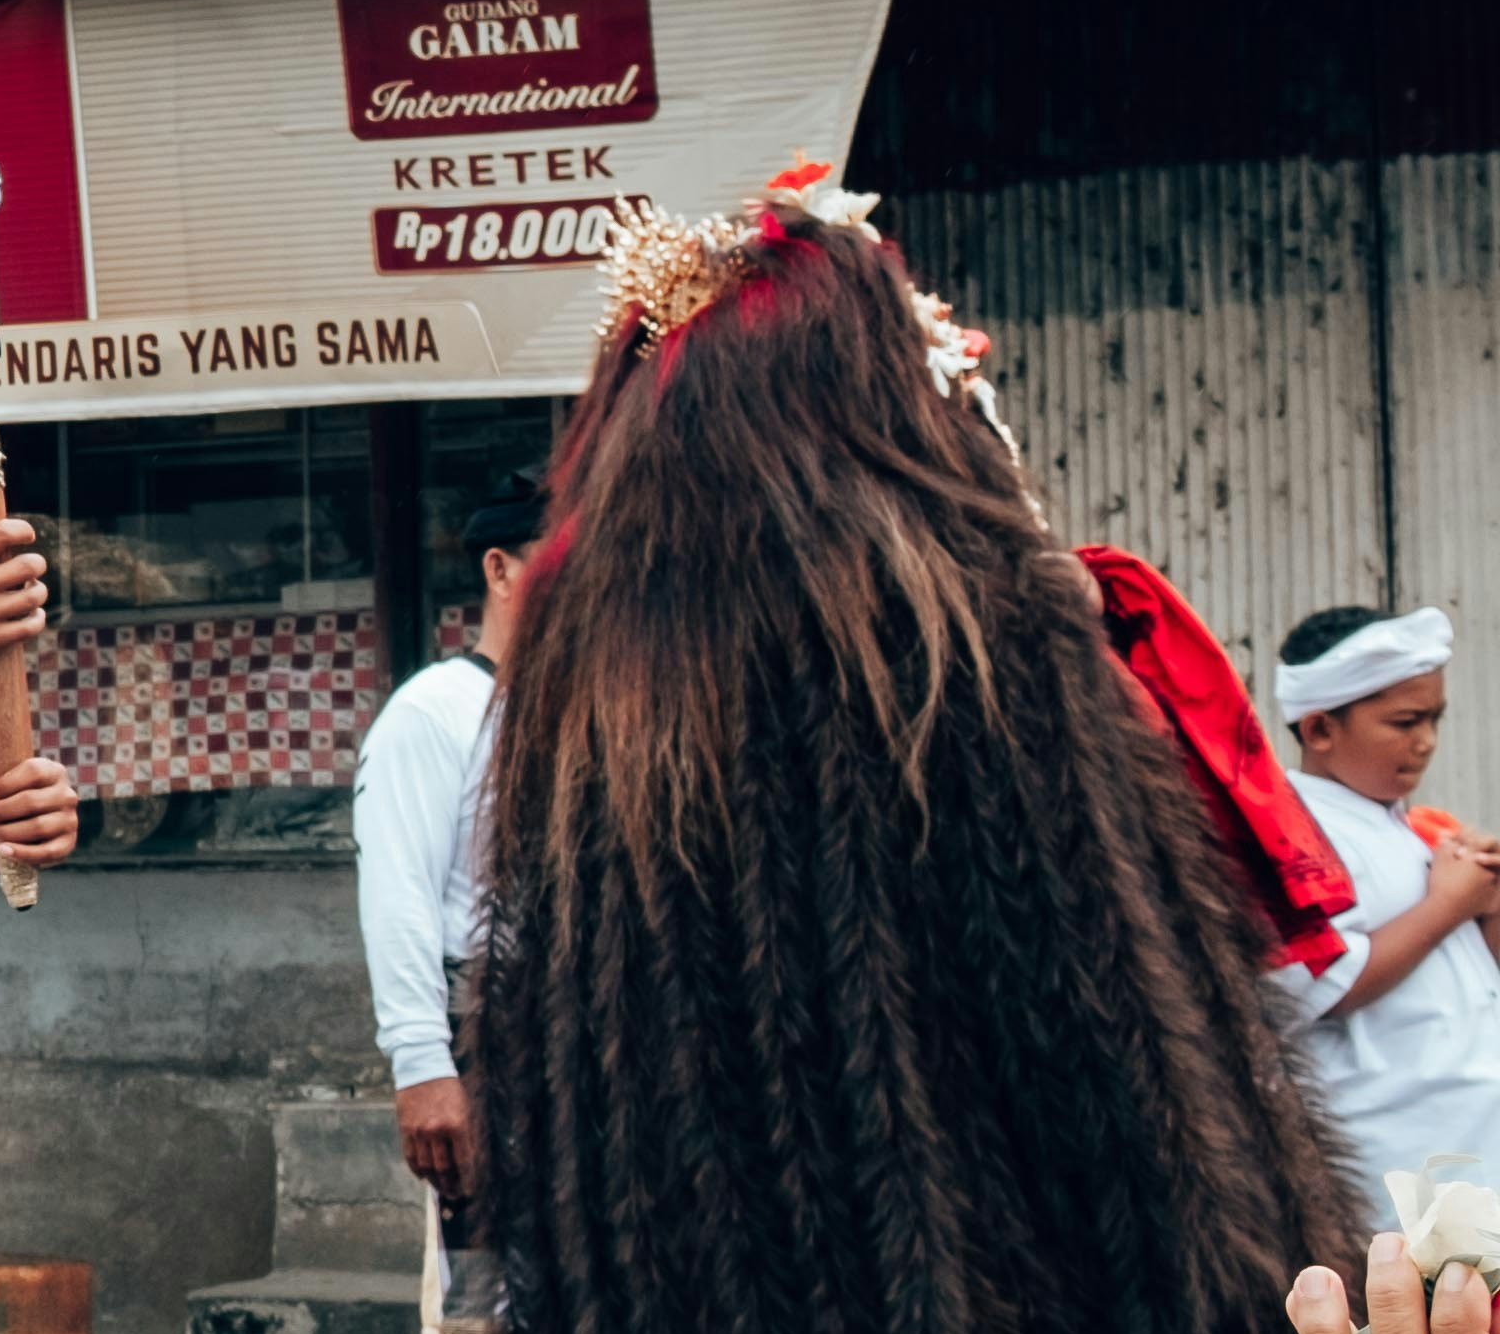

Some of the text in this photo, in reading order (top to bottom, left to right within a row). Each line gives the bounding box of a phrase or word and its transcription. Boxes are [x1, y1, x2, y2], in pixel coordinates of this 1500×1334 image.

[409, 13, 580, 60] GARAM
[365, 64, 640, 122] International
[393, 145, 615, 190] KRETEK
[394, 205, 613, 262] Rp18.000
[180, 323, 298, 374] YANG
[316, 317, 440, 366] SAMA
